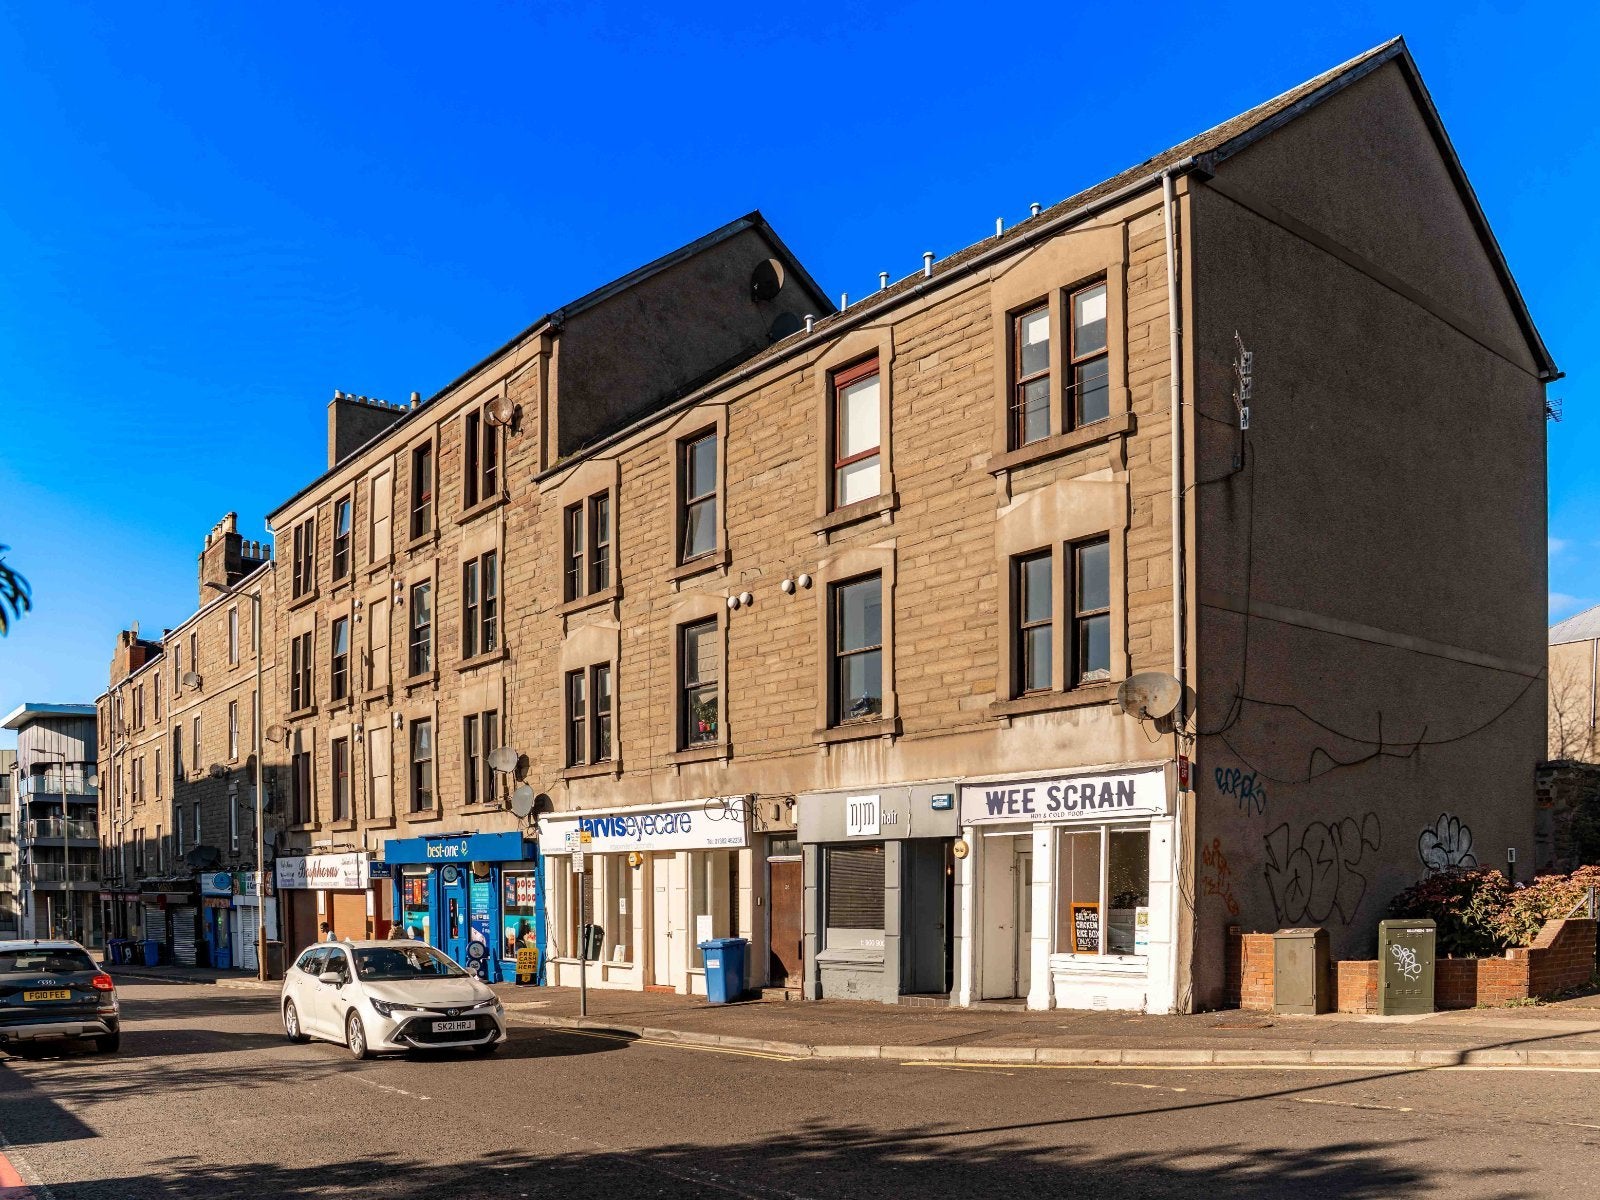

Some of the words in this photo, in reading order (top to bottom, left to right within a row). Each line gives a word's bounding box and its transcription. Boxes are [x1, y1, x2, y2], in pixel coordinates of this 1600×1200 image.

[985, 788, 1036, 816] WEE
[1046, 780, 1137, 812] SCRAN
[850, 801, 875, 833] njm
[881, 810, 898, 825] hair
[427, 841, 459, 858] best-one
[49, 991, 66, 999] FEE
[437, 1022, 455, 1031] SK21
[456, 1021, 472, 1030] HRJ
